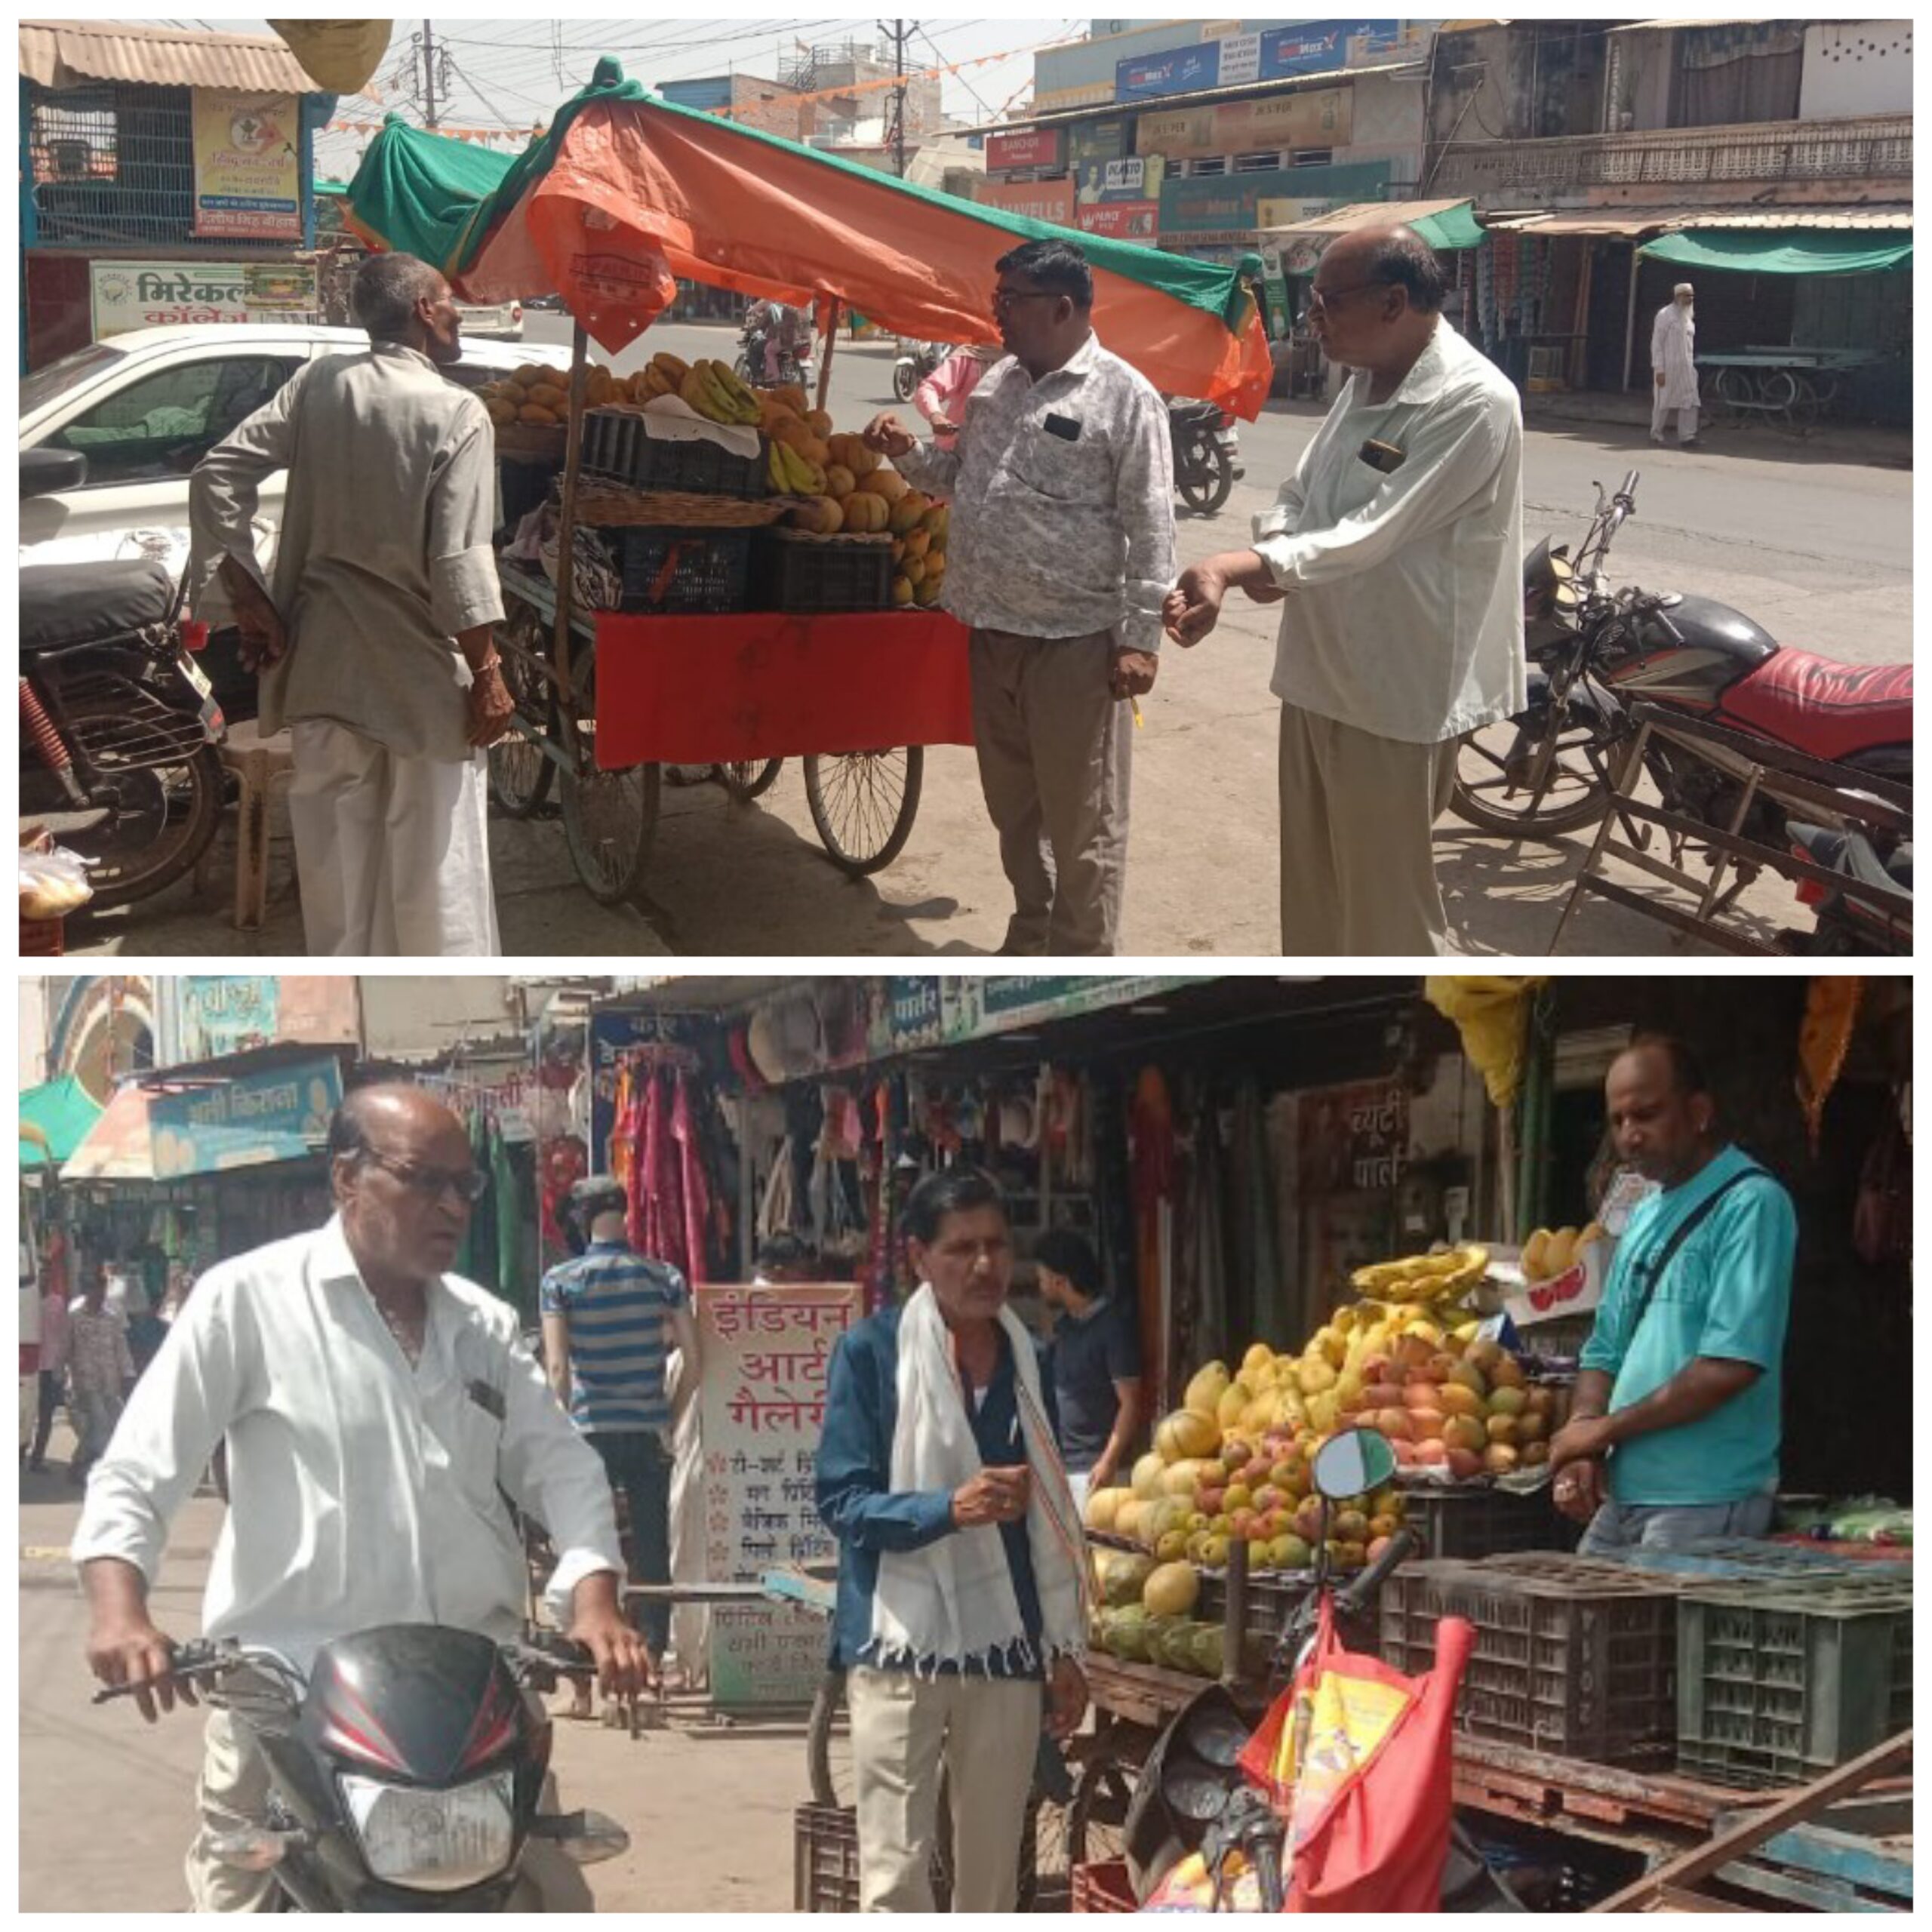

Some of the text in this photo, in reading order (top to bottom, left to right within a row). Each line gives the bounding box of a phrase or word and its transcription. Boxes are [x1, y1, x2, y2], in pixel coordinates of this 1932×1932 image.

[712, 1291, 853, 1340] इंडियन
[739, 1337, 827, 1383] आर्ट
[726, 1386, 826, 1432] गैलेर
